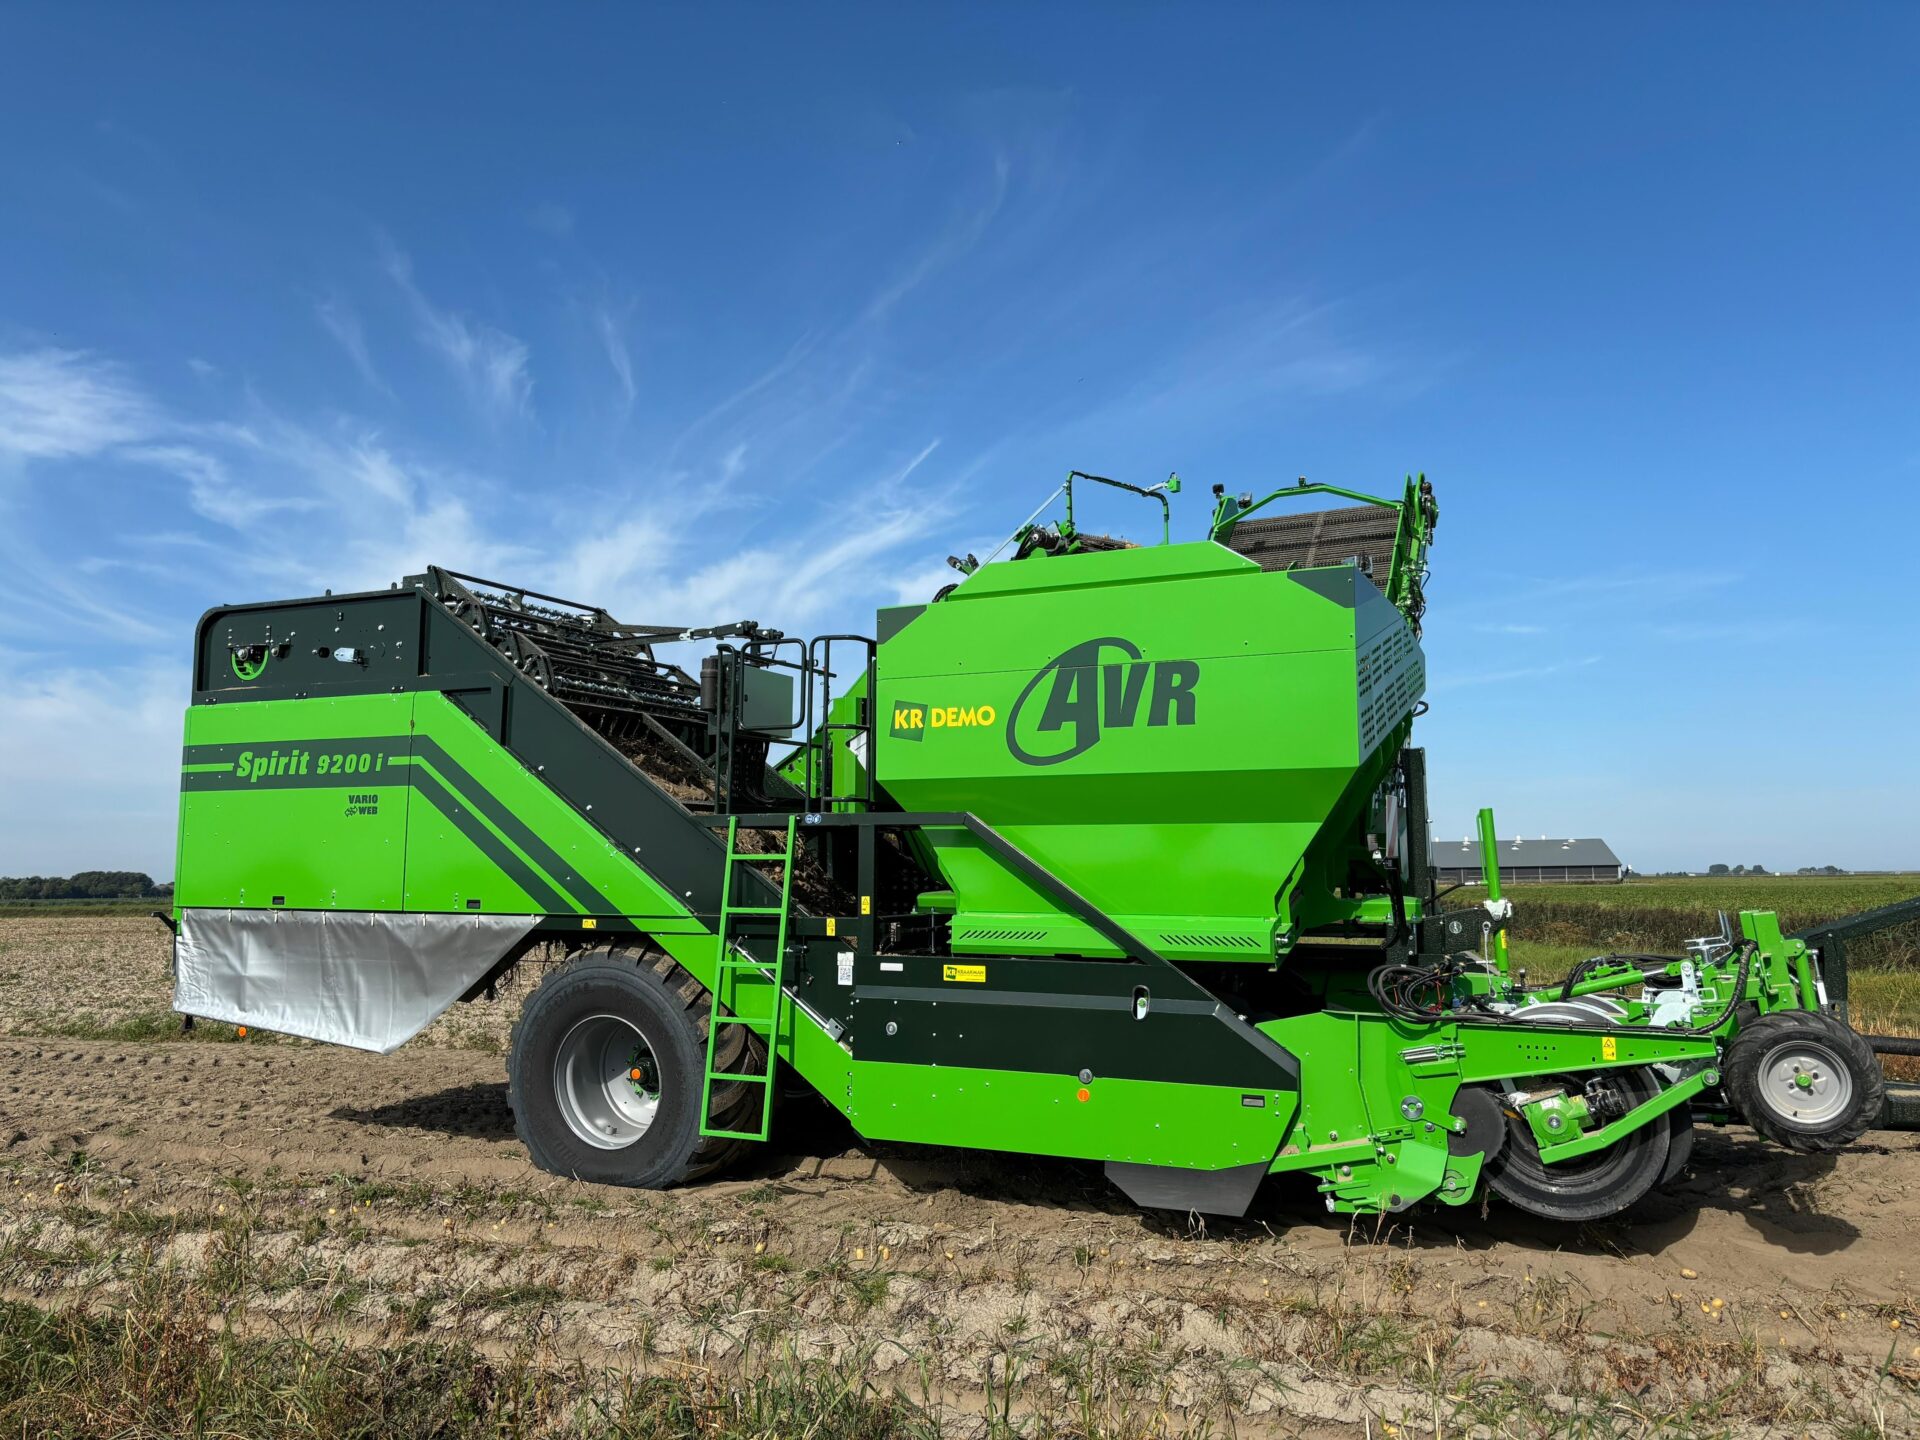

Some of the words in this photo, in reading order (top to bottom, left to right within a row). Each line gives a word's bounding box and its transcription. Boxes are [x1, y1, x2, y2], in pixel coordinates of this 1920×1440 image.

[1006, 637, 1200, 766] AVR
[894, 708, 924, 730] KR
[931, 705, 996, 728] DEMO
[236, 749, 310, 783] Spirit
[316, 753, 372, 775] 9200
[375, 753, 384, 772] i
[348, 794, 379, 804] VARIO
[358, 806, 378, 815] WEB
